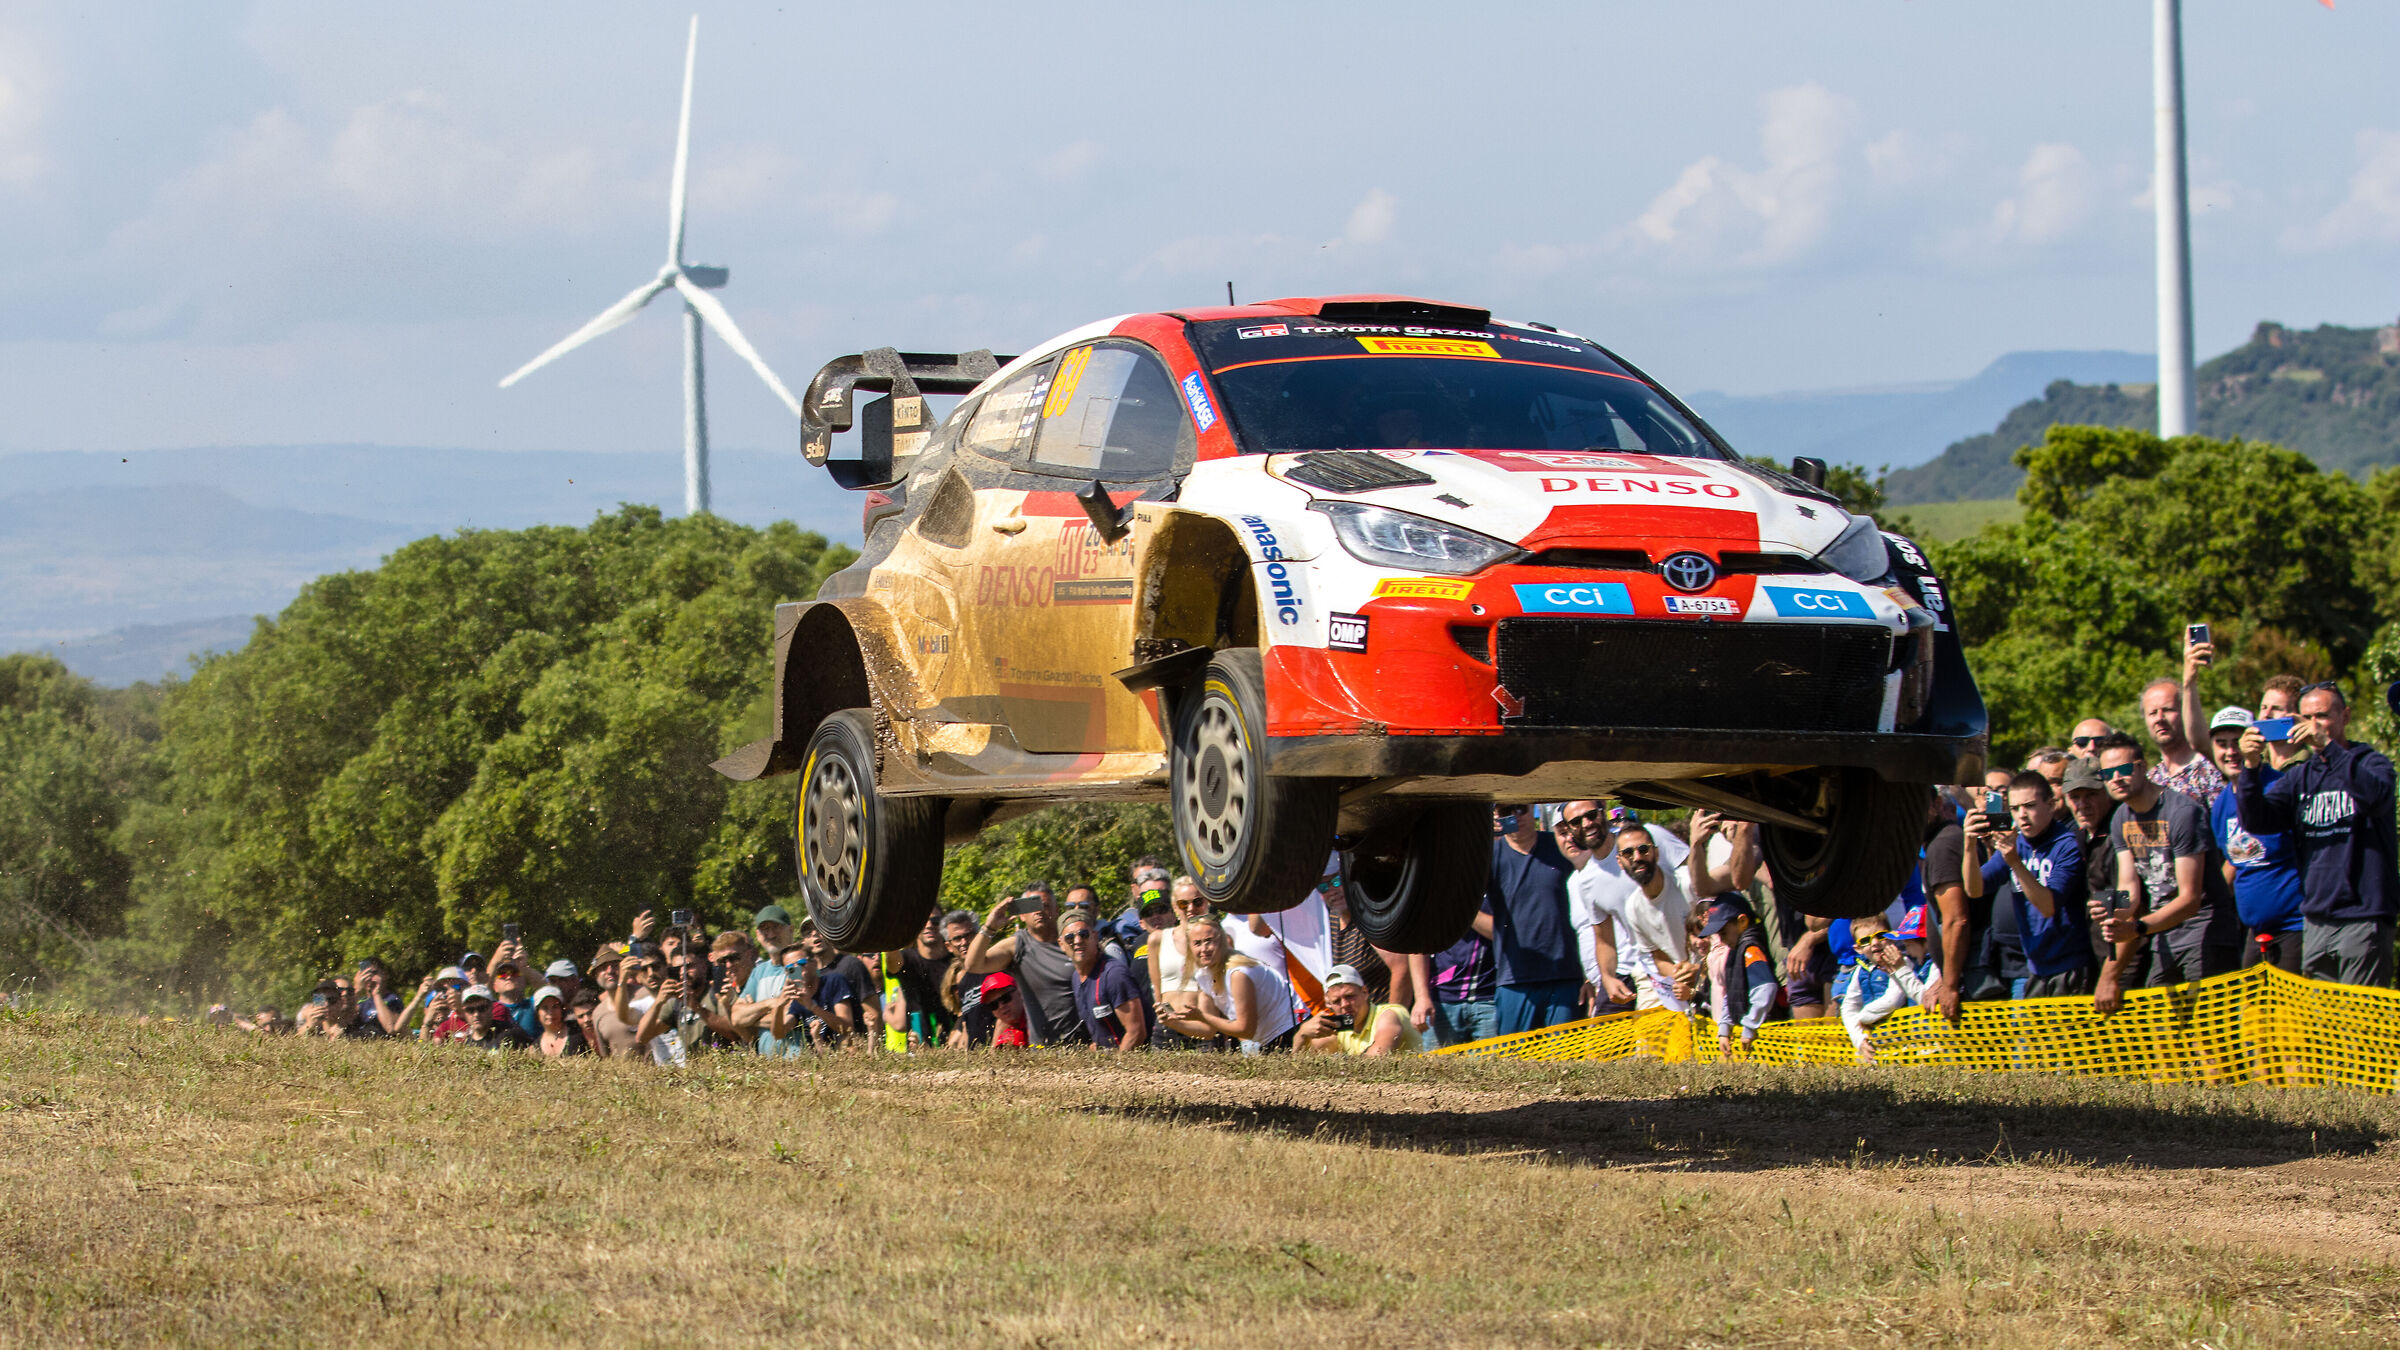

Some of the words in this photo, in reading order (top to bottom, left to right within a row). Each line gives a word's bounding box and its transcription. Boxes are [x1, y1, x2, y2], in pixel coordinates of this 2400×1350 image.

[1241, 328, 1286, 339] GR
[1294, 326, 1400, 334] TOYOTA
[1404, 326, 1496, 339] GAZOO
[1499, 333, 1583, 353] Racing
[1373, 340, 1485, 354] PIRELLI
[1042, 346, 1093, 419] 69
[1540, 477, 1740, 499] DENSO
[1083, 549, 1099, 574] 23
[976, 565, 1055, 609] DENSO
[1376, 580, 1465, 597] PIRELLI
[1682, 600, 1727, 611] A-6754
[1331, 622, 1366, 644] OMP
